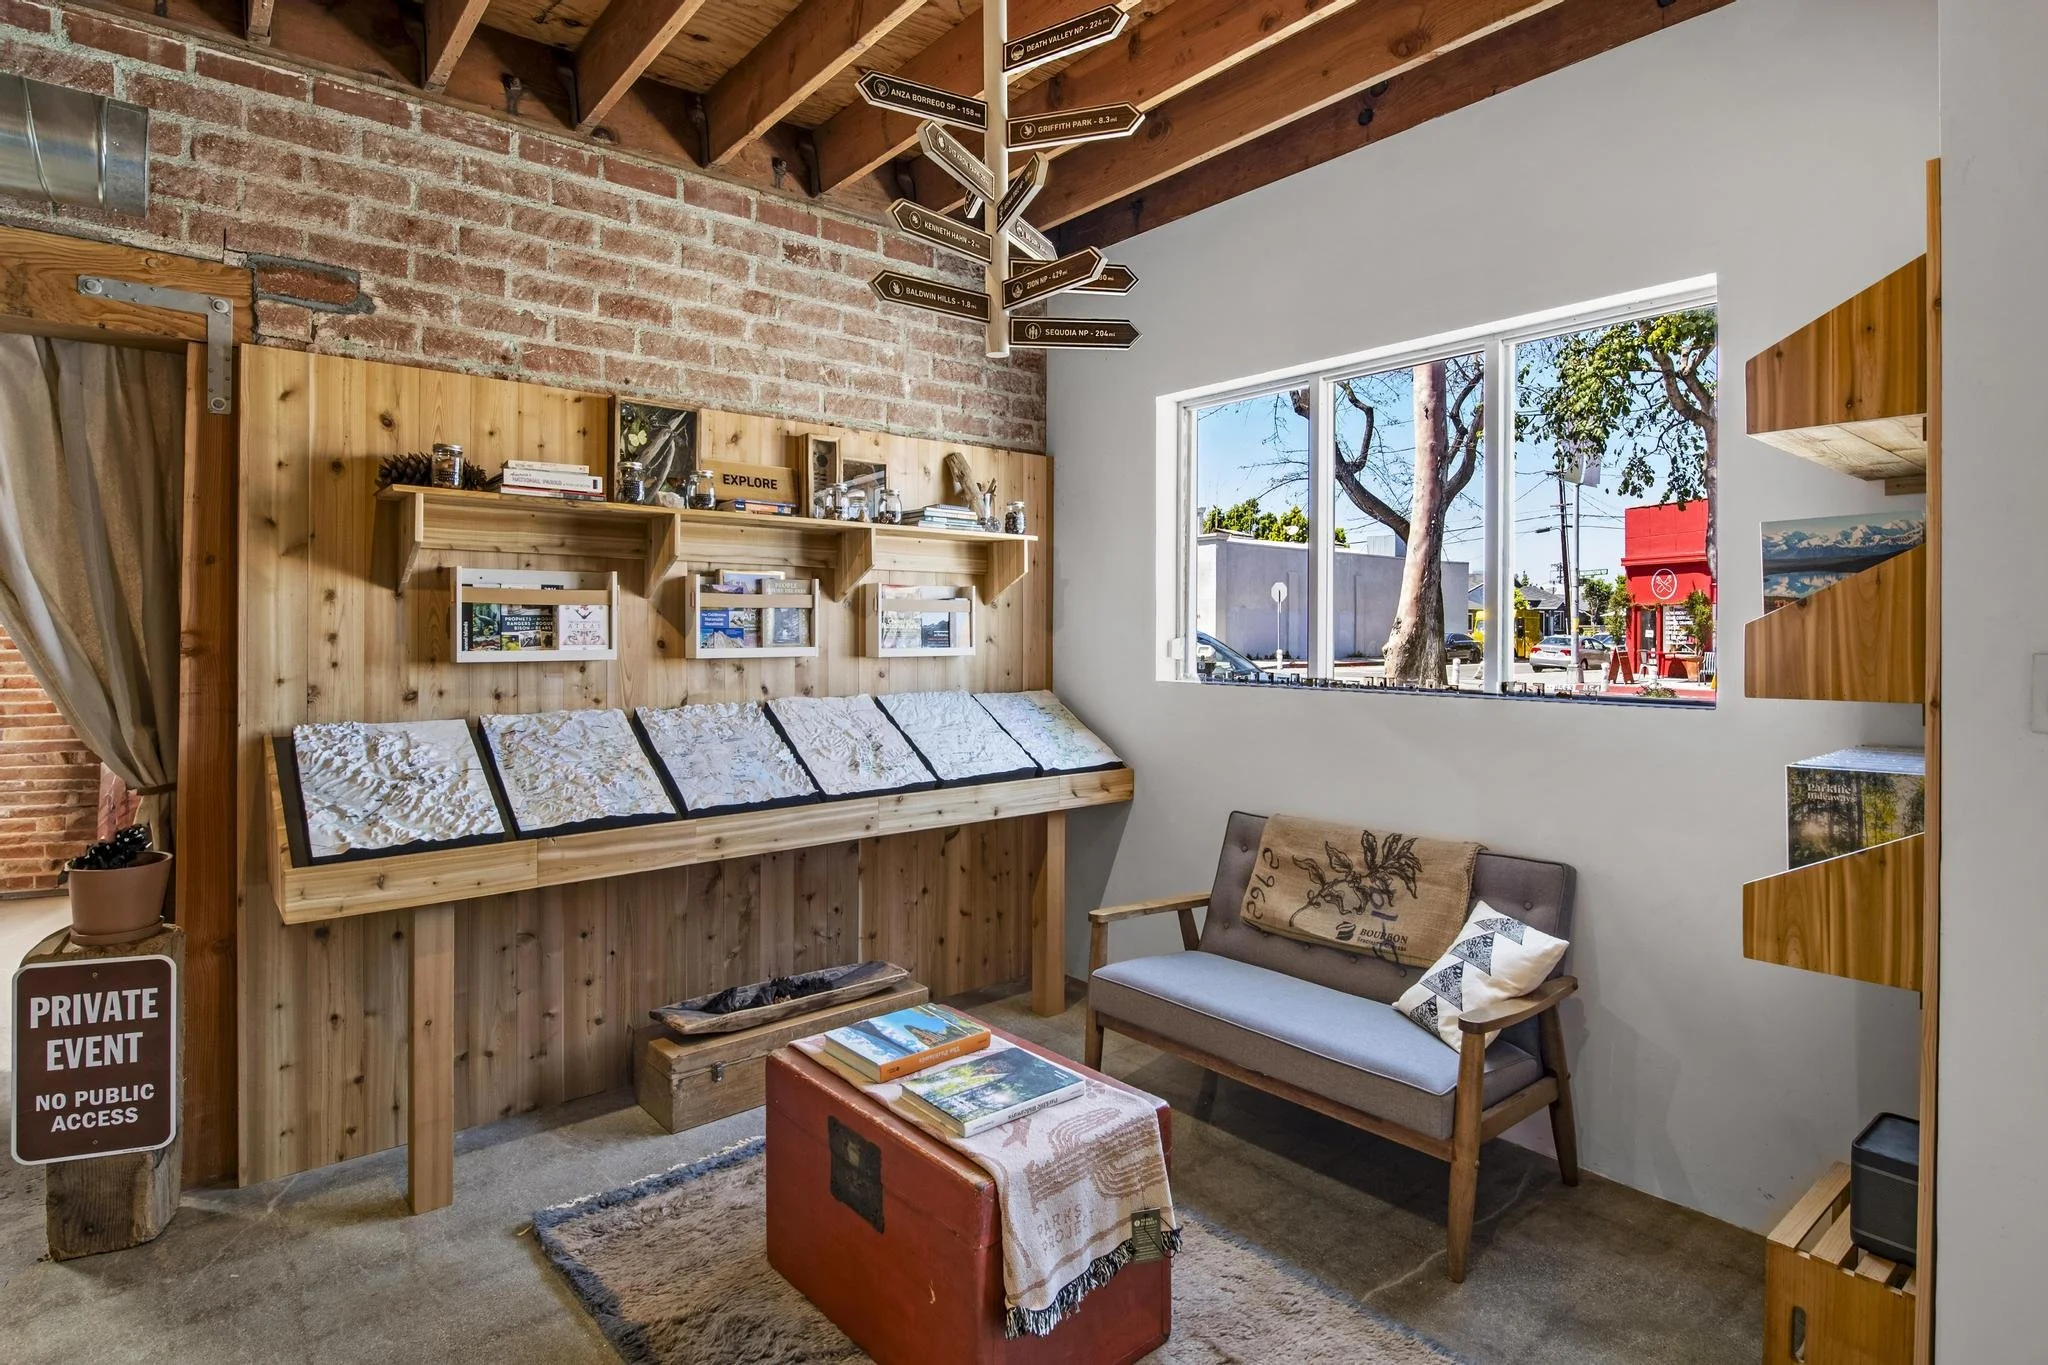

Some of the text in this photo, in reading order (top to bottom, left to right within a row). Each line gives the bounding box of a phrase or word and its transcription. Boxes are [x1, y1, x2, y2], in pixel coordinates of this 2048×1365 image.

[1026, 40, 1048, 52] DEATH
[1048, 30, 1074, 44] VALLEY
[1074, 26, 1084, 35] NP
[890, 89, 911, 99] ANZA
[912, 94, 945, 108] BORREGO
[946, 102, 956, 111] SP
[1038, 121, 1071, 133] GRIFFITH
[1072, 118, 1092, 128] PARK
[924, 221, 951, 237] KENNETH
[951, 231, 967, 244] HAHN
[906, 287, 936, 300] BALDWIN
[937, 294, 956, 304] HILLS
[722, 474, 778, 490] EXPLORE
[1360, 928, 1408, 944] BOURBON
[30, 987, 158, 1028] PRIVATE
[47, 1031, 143, 1071] EVENT
[35, 1084, 155, 1112] NO PUBLIC
[51, 1107, 138, 1133] ACCESS
